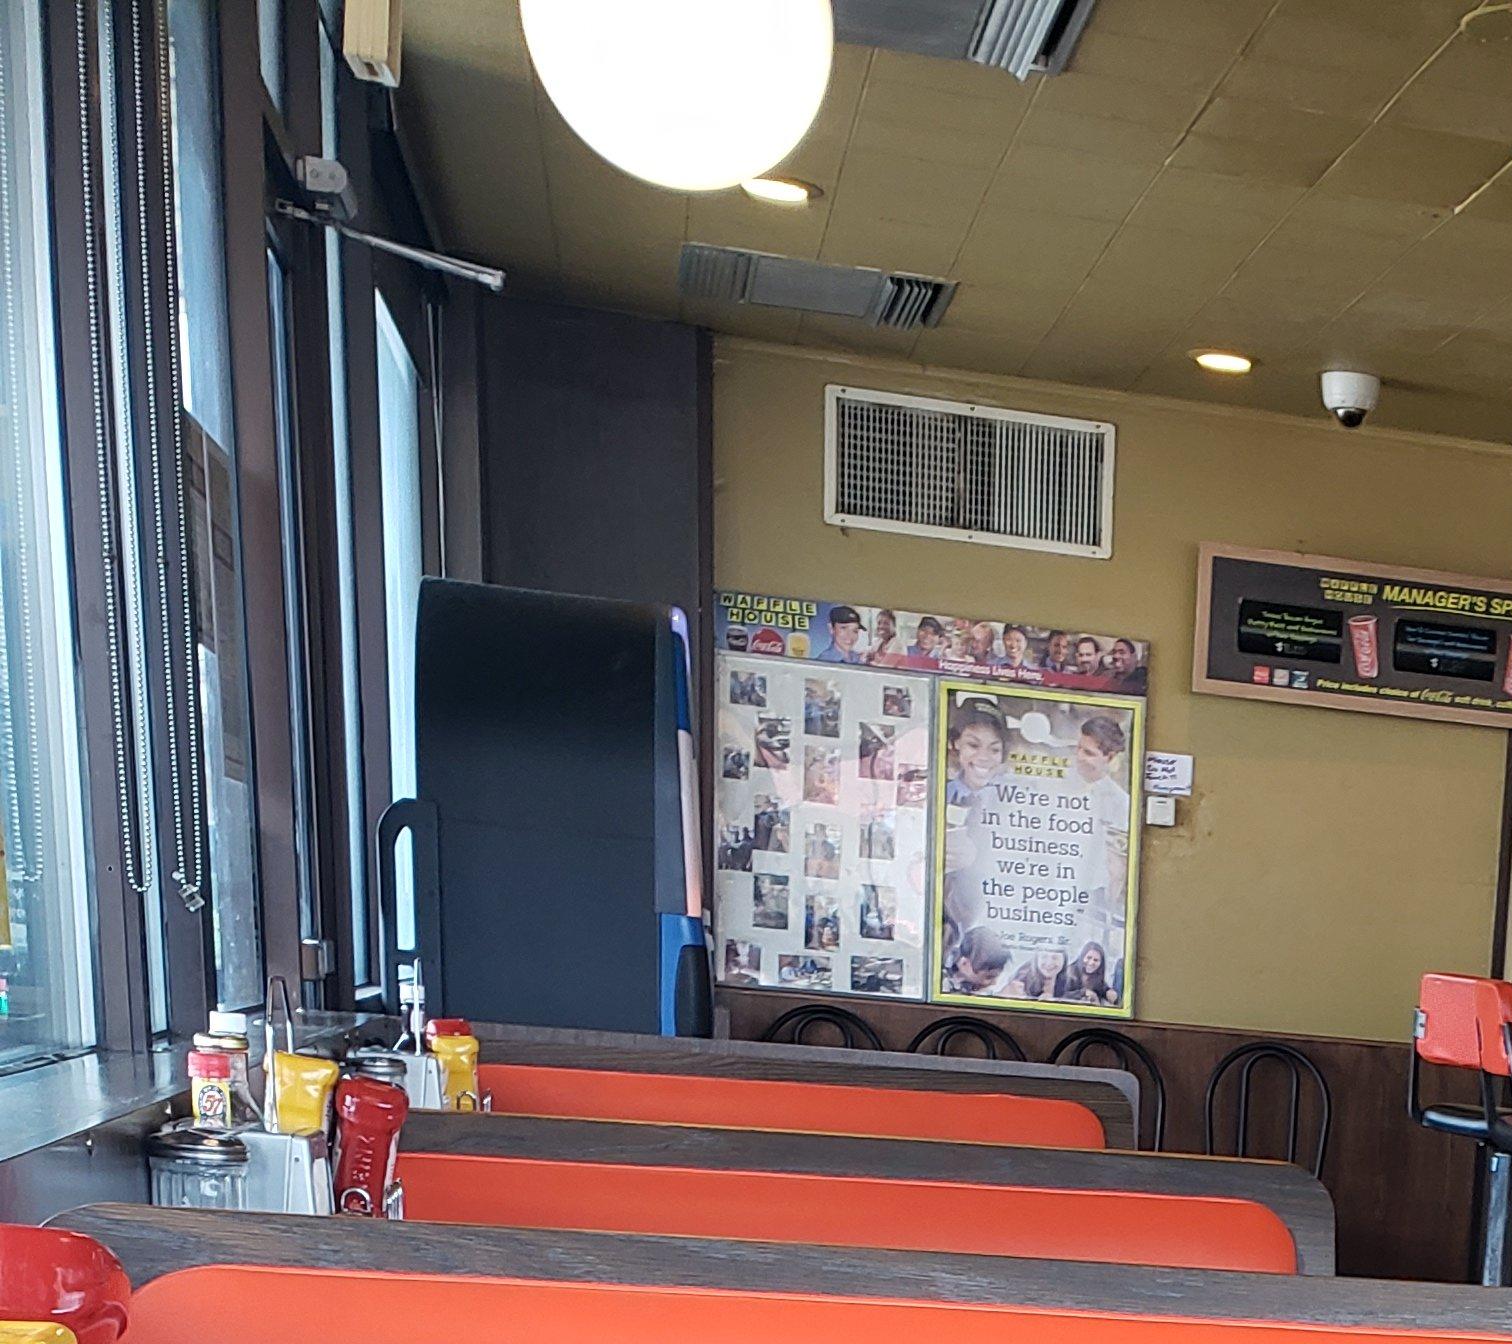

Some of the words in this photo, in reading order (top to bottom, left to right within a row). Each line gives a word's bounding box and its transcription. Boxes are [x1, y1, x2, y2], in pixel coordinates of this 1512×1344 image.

[721, 594, 816, 615] WAFFLE
[1382, 585, 1488, 612] MANAGER'S
[728, 608, 809, 629] HOUSE
[1009, 753, 1073, 767] WAFFLE
[1014, 765, 1067, 778] HOUSE
[1056, 794, 1090, 811] not
[981, 809, 1001, 826] in
[1008, 810, 1042, 830] the
[1048, 814, 1094, 834] food
[996, 858, 1050, 878] we're
[1055, 863, 1075, 880] in
[982, 879, 1015, 898] the
[1021, 885, 1090, 907] people
[203, 1095, 223, 1114] 57
